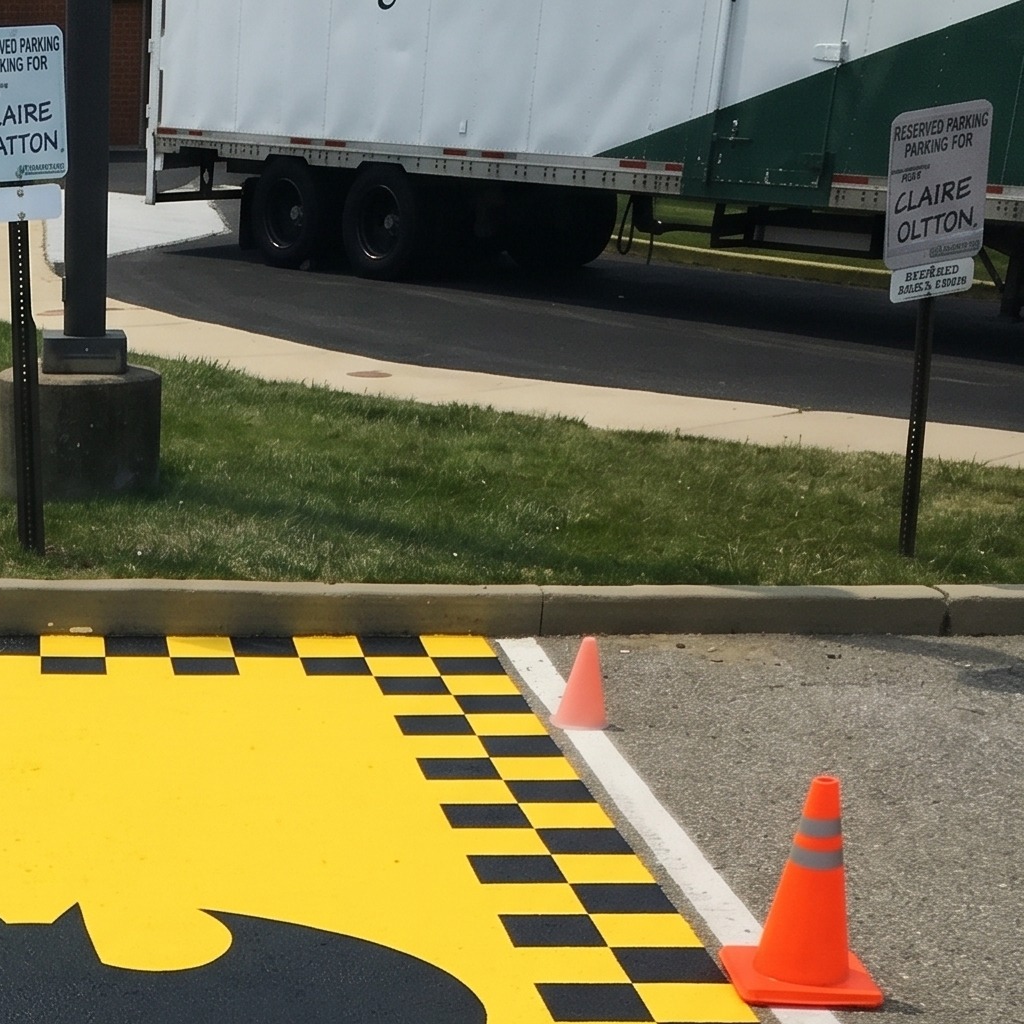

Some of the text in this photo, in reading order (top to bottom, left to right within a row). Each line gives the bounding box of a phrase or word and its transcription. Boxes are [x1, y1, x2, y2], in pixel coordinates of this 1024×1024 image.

[19, 36, 60, 53] PARKING
[26, 55, 48, 71] FOR
[894, 112, 989, 141] RESERVED PARKING
[904, 132, 973, 158] PARKING FOR
[894, 176, 972, 214] CLAIRE
